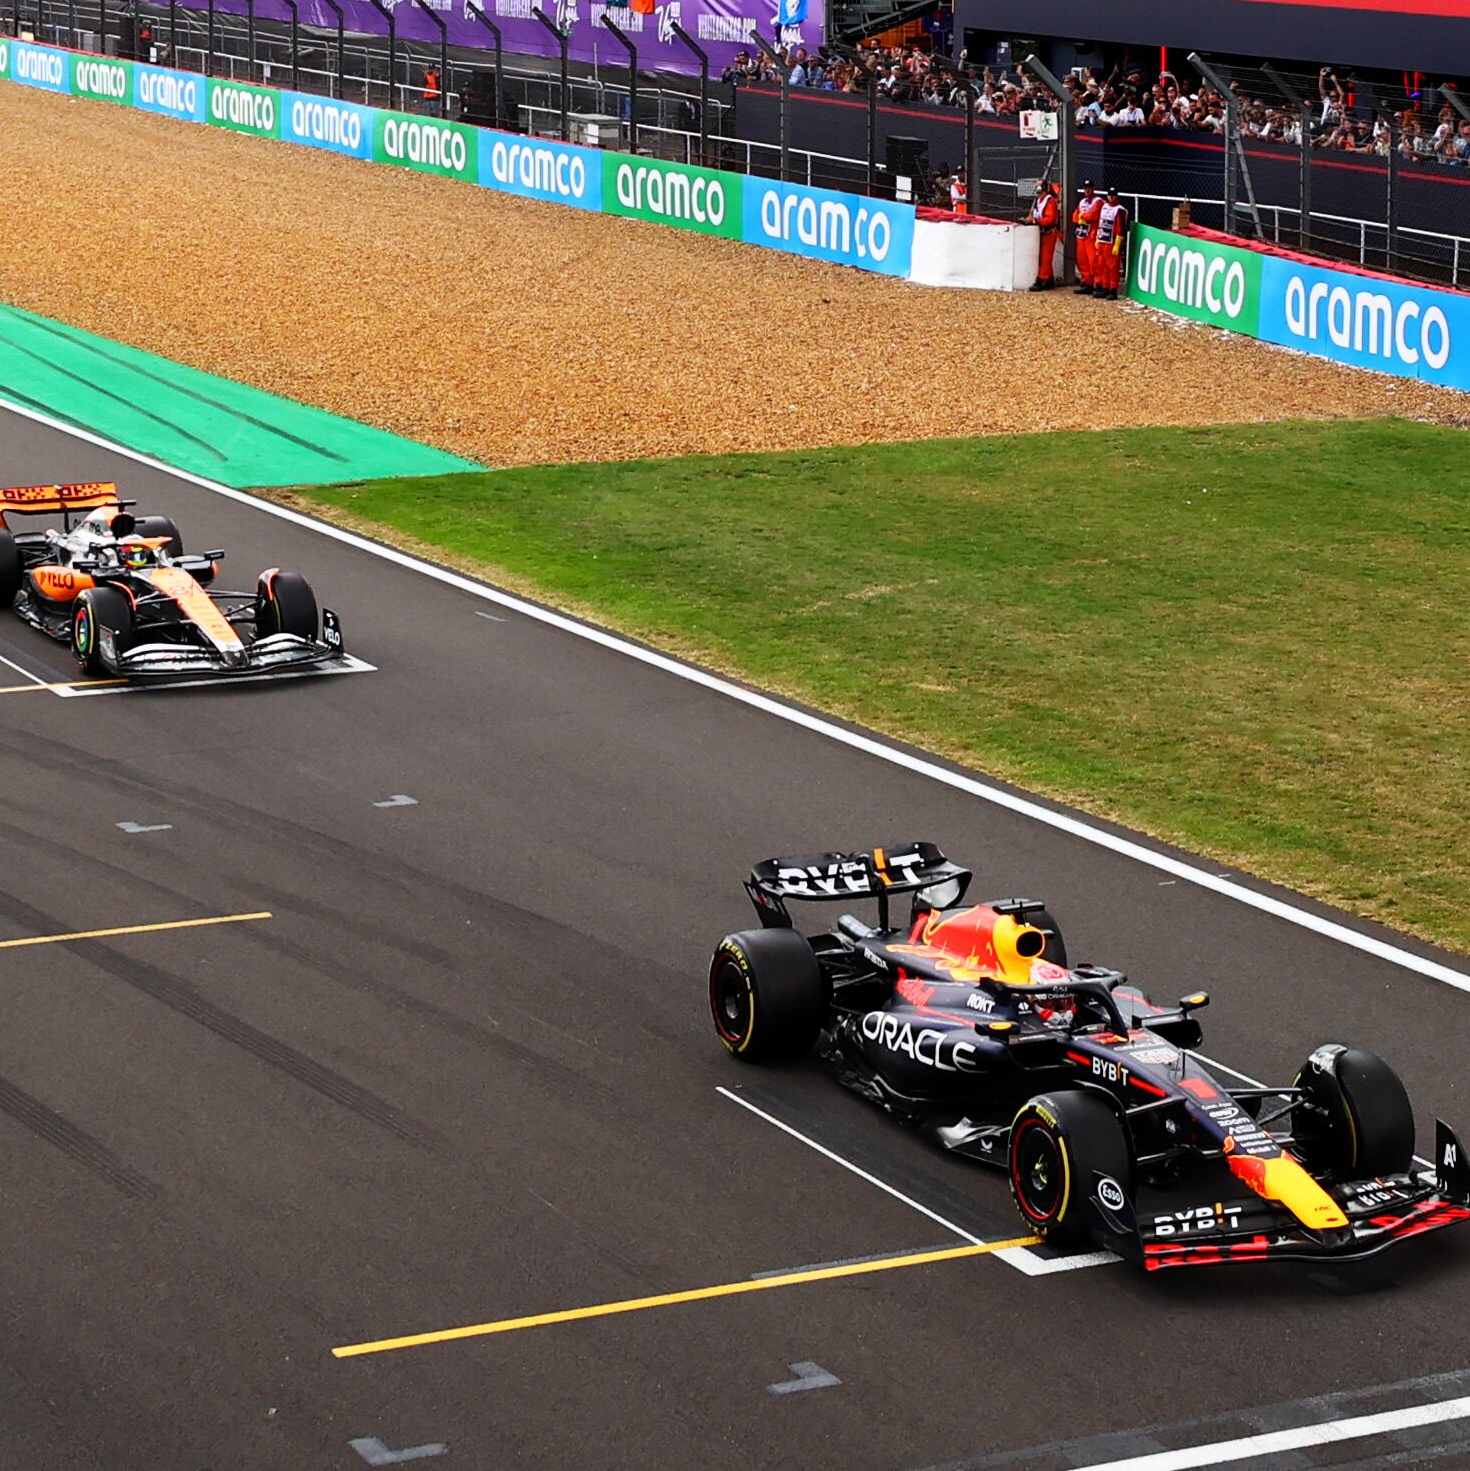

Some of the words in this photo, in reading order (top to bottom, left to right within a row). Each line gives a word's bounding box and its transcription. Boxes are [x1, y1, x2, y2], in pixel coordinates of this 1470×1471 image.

[17, 49, 63, 86] aramco
[76, 60, 125, 98] aramco
[140, 71, 195, 114] aramco
[212, 85, 273, 131] aramco
[292, 101, 361, 149] aramco
[384, 119, 466, 172] aramco
[492, 141, 585, 198] aramco
[617, 164, 724, 226] aramco
[761, 190, 891, 261] aramco
[1137, 236, 1245, 318] aramco
[1285, 276, 1450, 369] aramco
[778, 848, 922, 896] BYBIT
[966, 993, 996, 1014] ROKT
[862, 1010, 987, 1074] ORACLE
[1092, 1056, 1129, 1087] BYBIT
[1443, 1143, 1458, 1169] A1
[1102, 1184, 1121, 1204] Esso
[1154, 1202, 1242, 1236] BYBIT
